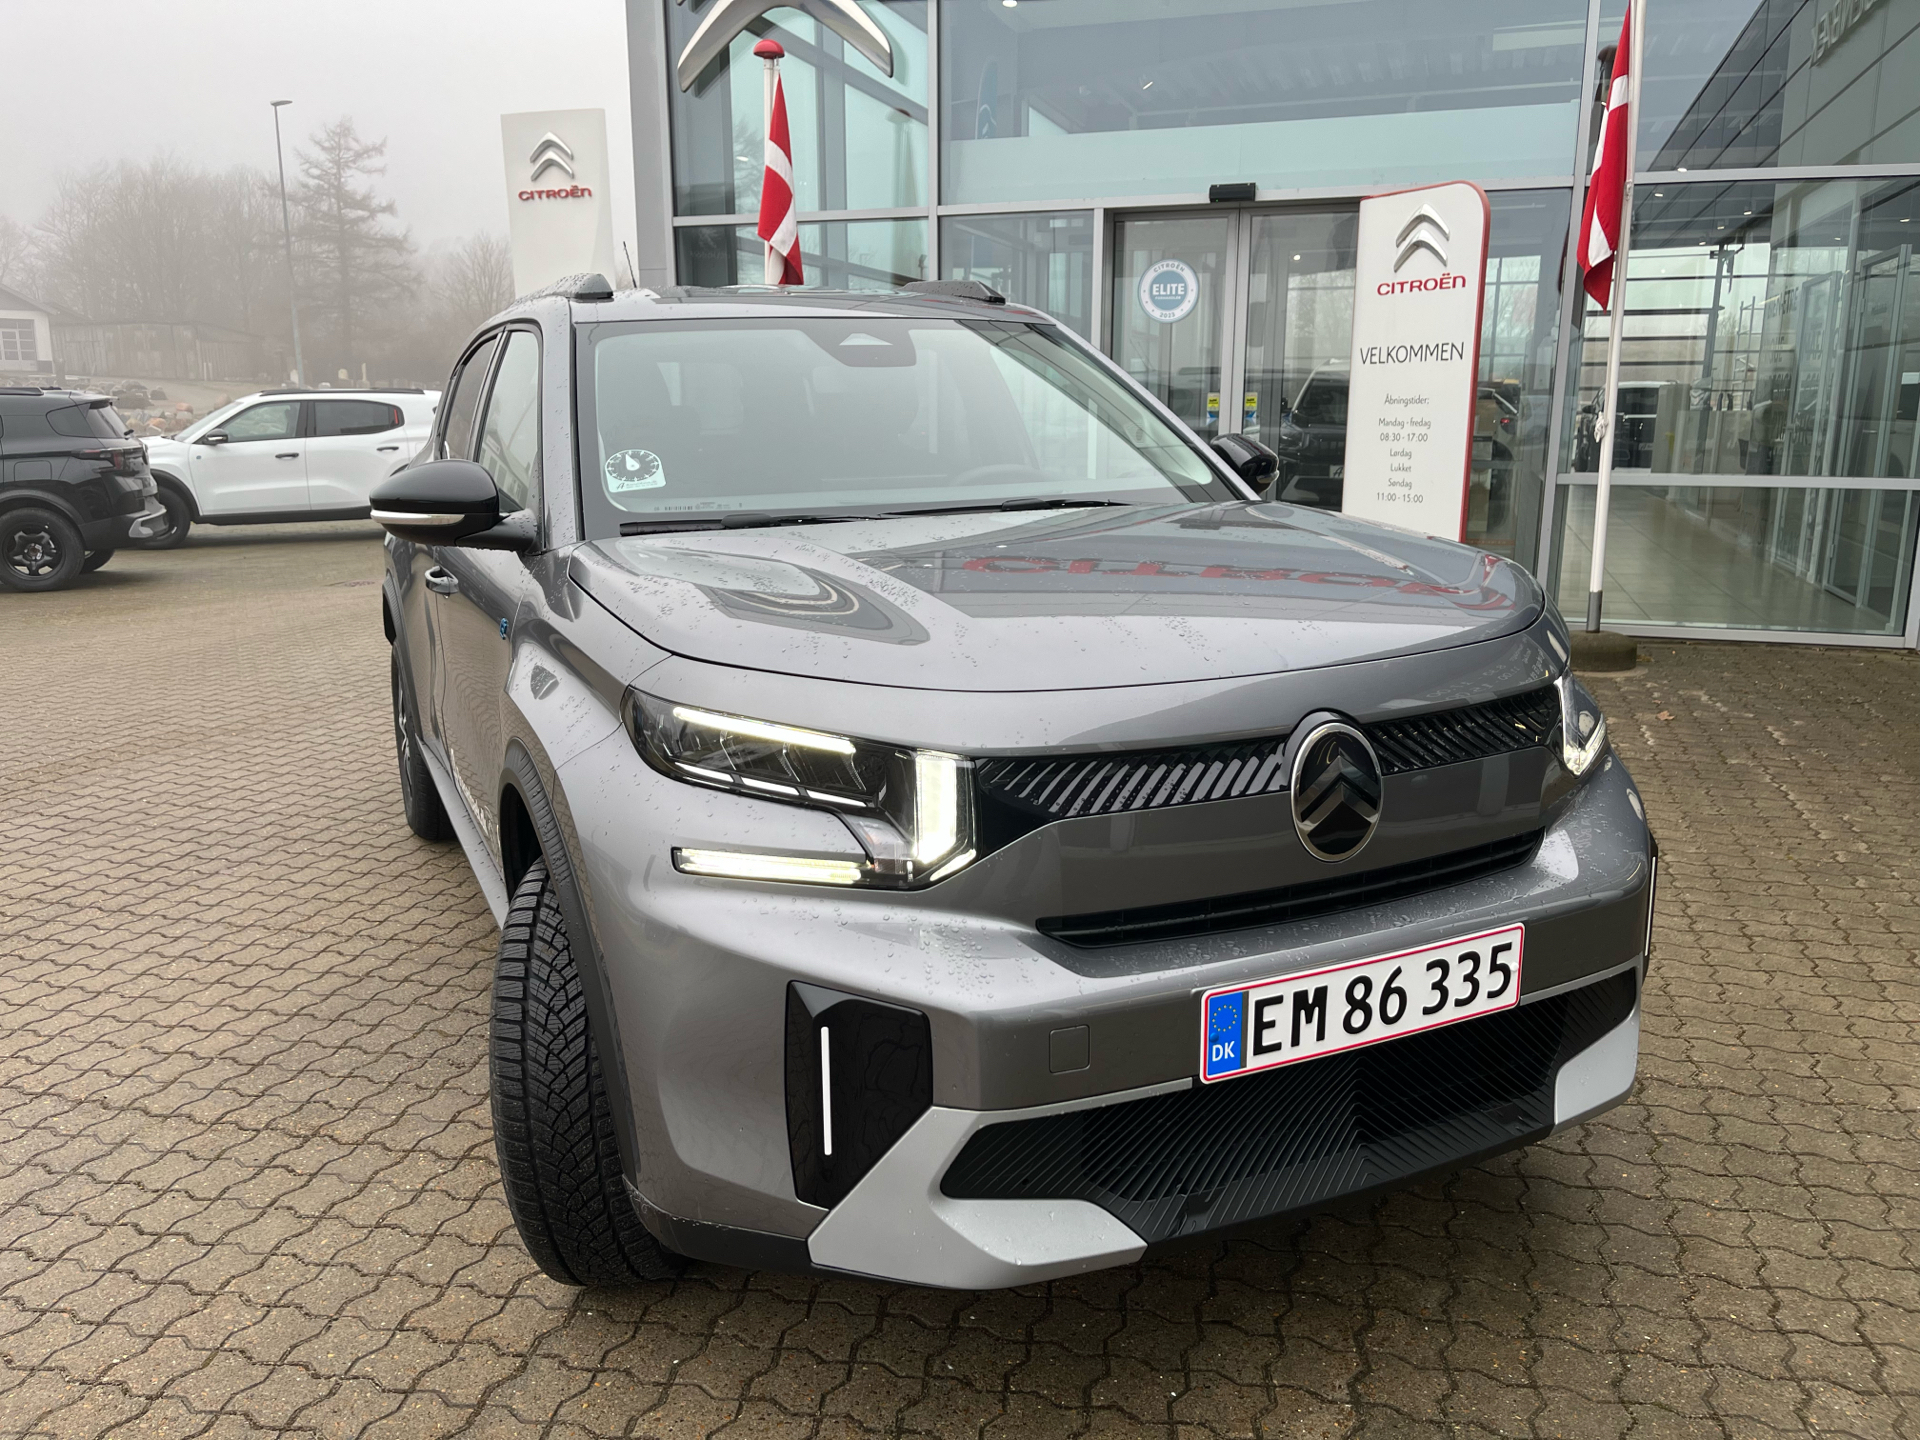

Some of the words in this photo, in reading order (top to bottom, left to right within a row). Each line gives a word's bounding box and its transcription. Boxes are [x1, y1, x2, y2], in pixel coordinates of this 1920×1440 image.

[518, 184, 592, 201] CITROËN
[1152, 283, 1185, 295] ELITE
[1377, 272, 1466, 296] CITROËN
[1360, 342, 1464, 365] VELKOMMEN
[1378, 417, 1405, 430] Mandag
[1410, 417, 1432, 430] fredag
[1380, 432, 1401, 442] 08:30
[1407, 433, 1429, 442] 17:00
[1389, 447, 1412, 460] Lørdag
[1390, 462, 1412, 473] Lukket
[1388, 478, 1413, 491] Søndag
[1377, 492, 1397, 502] 11:00
[1402, 493, 1424, 503] 15:00
[1253, 985, 1329, 1056] EM
[1342, 965, 1408, 1035] 86
[1422, 941, 1513, 1016] 335
[1211, 1040, 1236, 1063] DK
